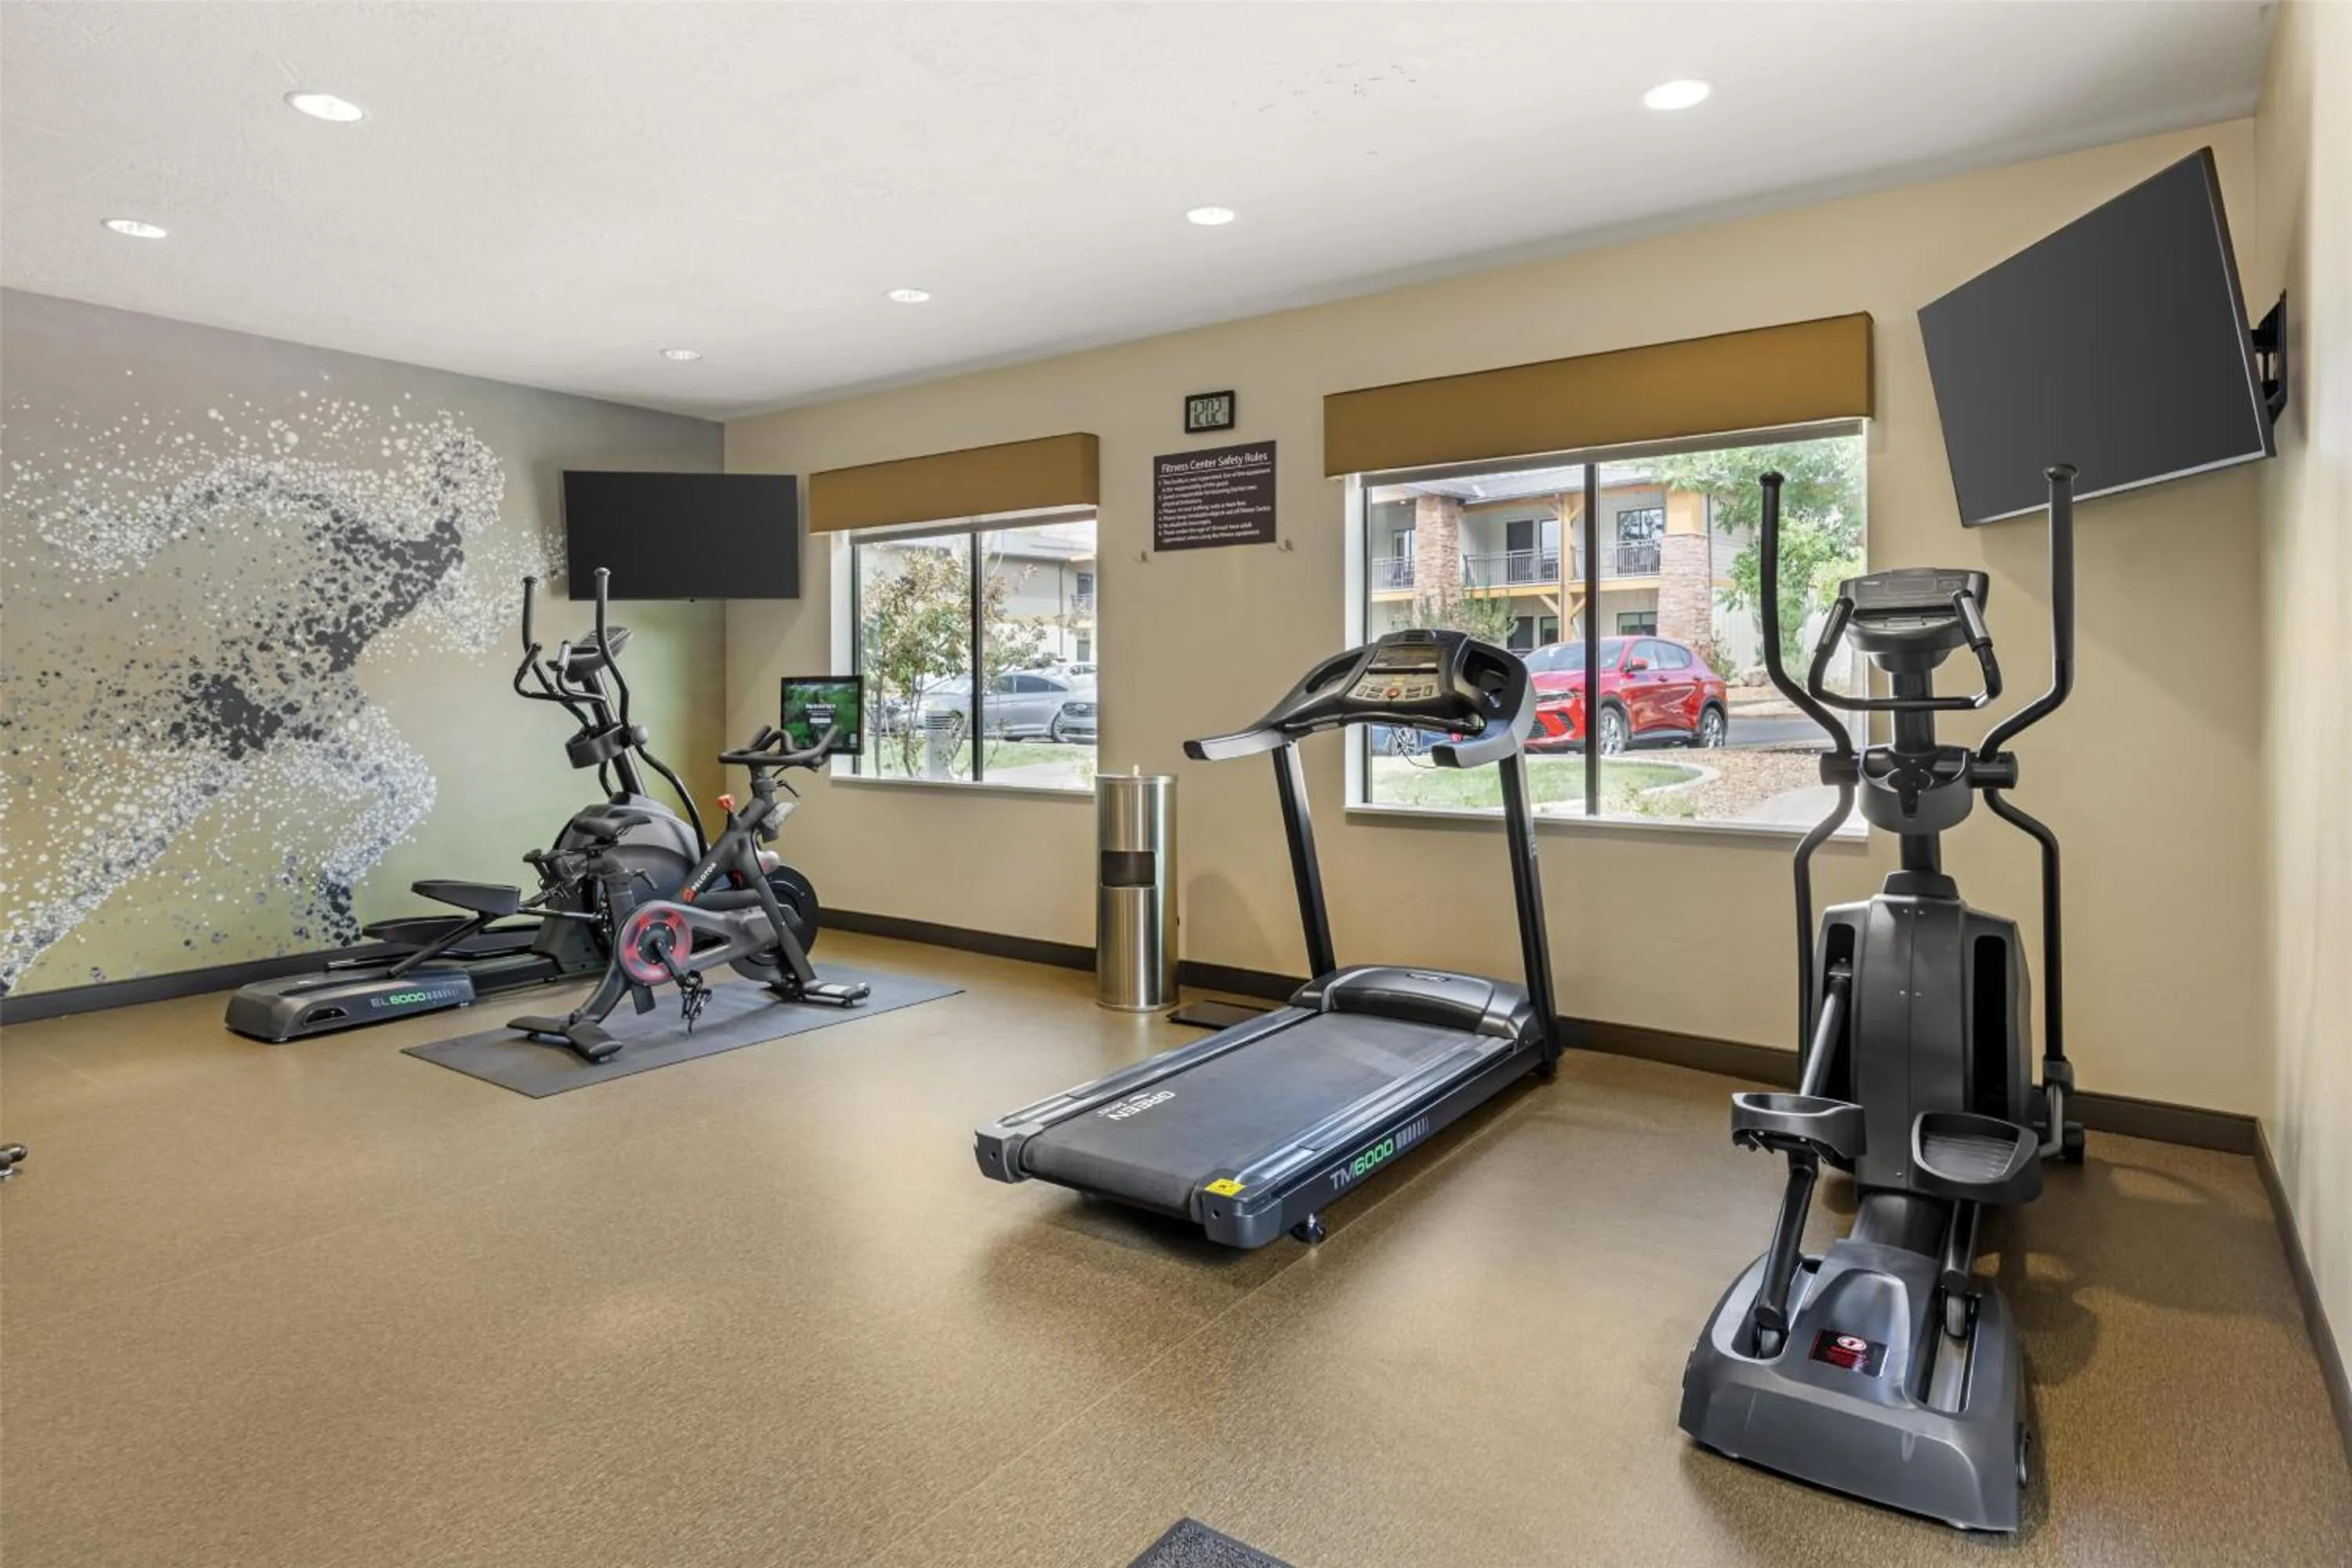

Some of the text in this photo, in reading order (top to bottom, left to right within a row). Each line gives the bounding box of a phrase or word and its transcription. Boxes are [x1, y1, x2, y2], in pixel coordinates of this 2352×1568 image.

[1162, 451, 1268, 474] Fitness Center Safety Rules
[691, 862, 717, 891] PELOTON
[1106, 1091, 1176, 1120] GREEN
